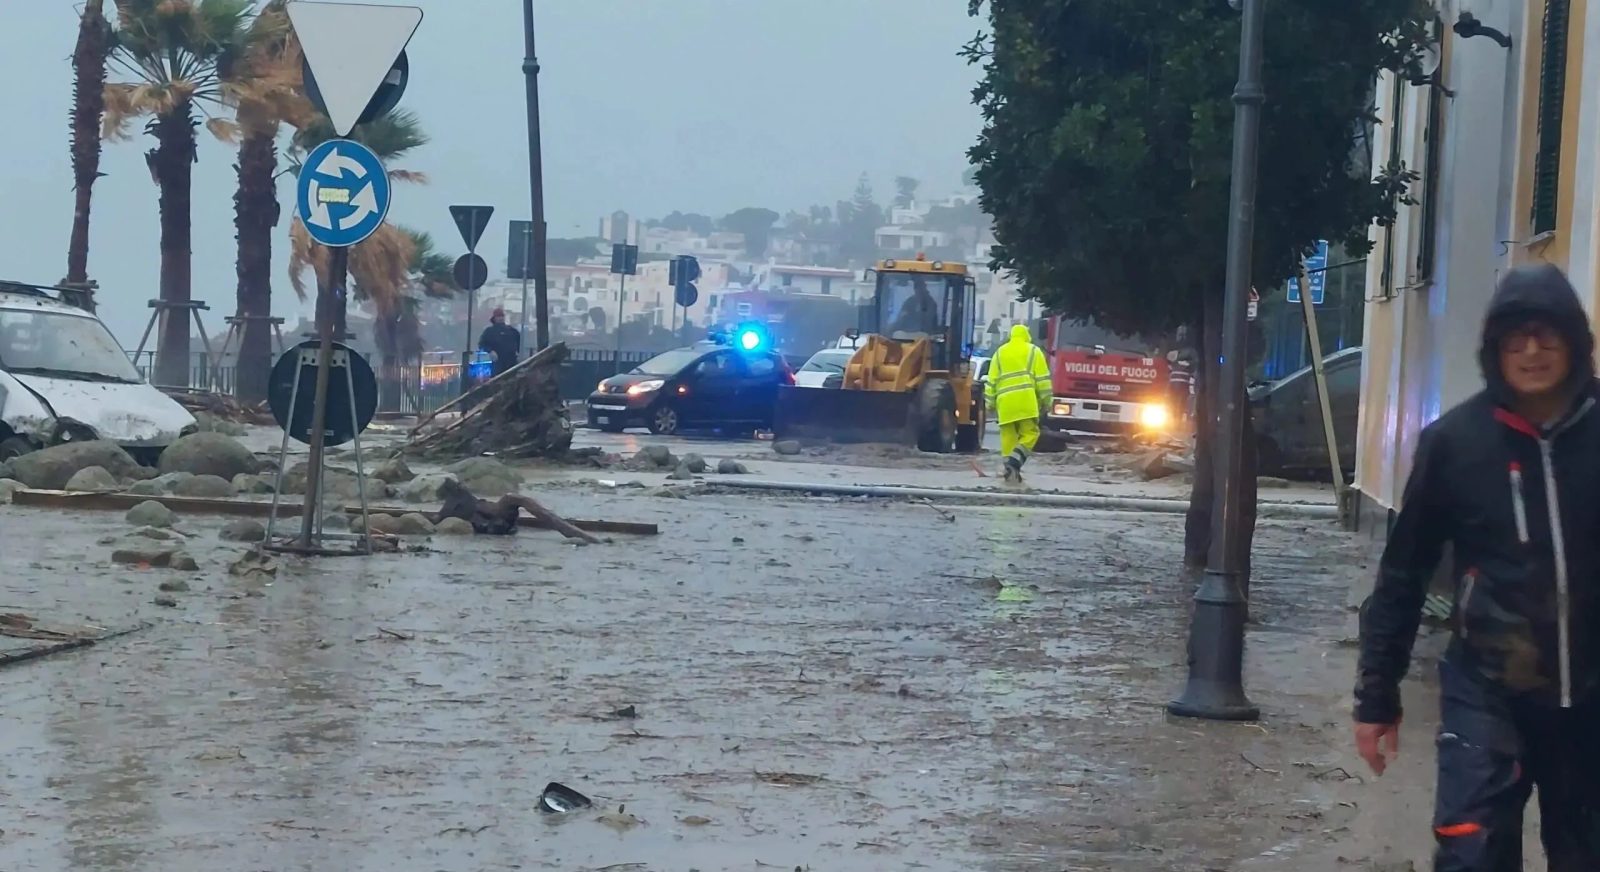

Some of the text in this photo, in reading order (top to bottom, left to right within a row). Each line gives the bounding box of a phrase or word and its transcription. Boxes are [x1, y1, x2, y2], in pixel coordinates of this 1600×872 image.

[1065, 362, 1157, 378] VIGILI DEL FUOCO
